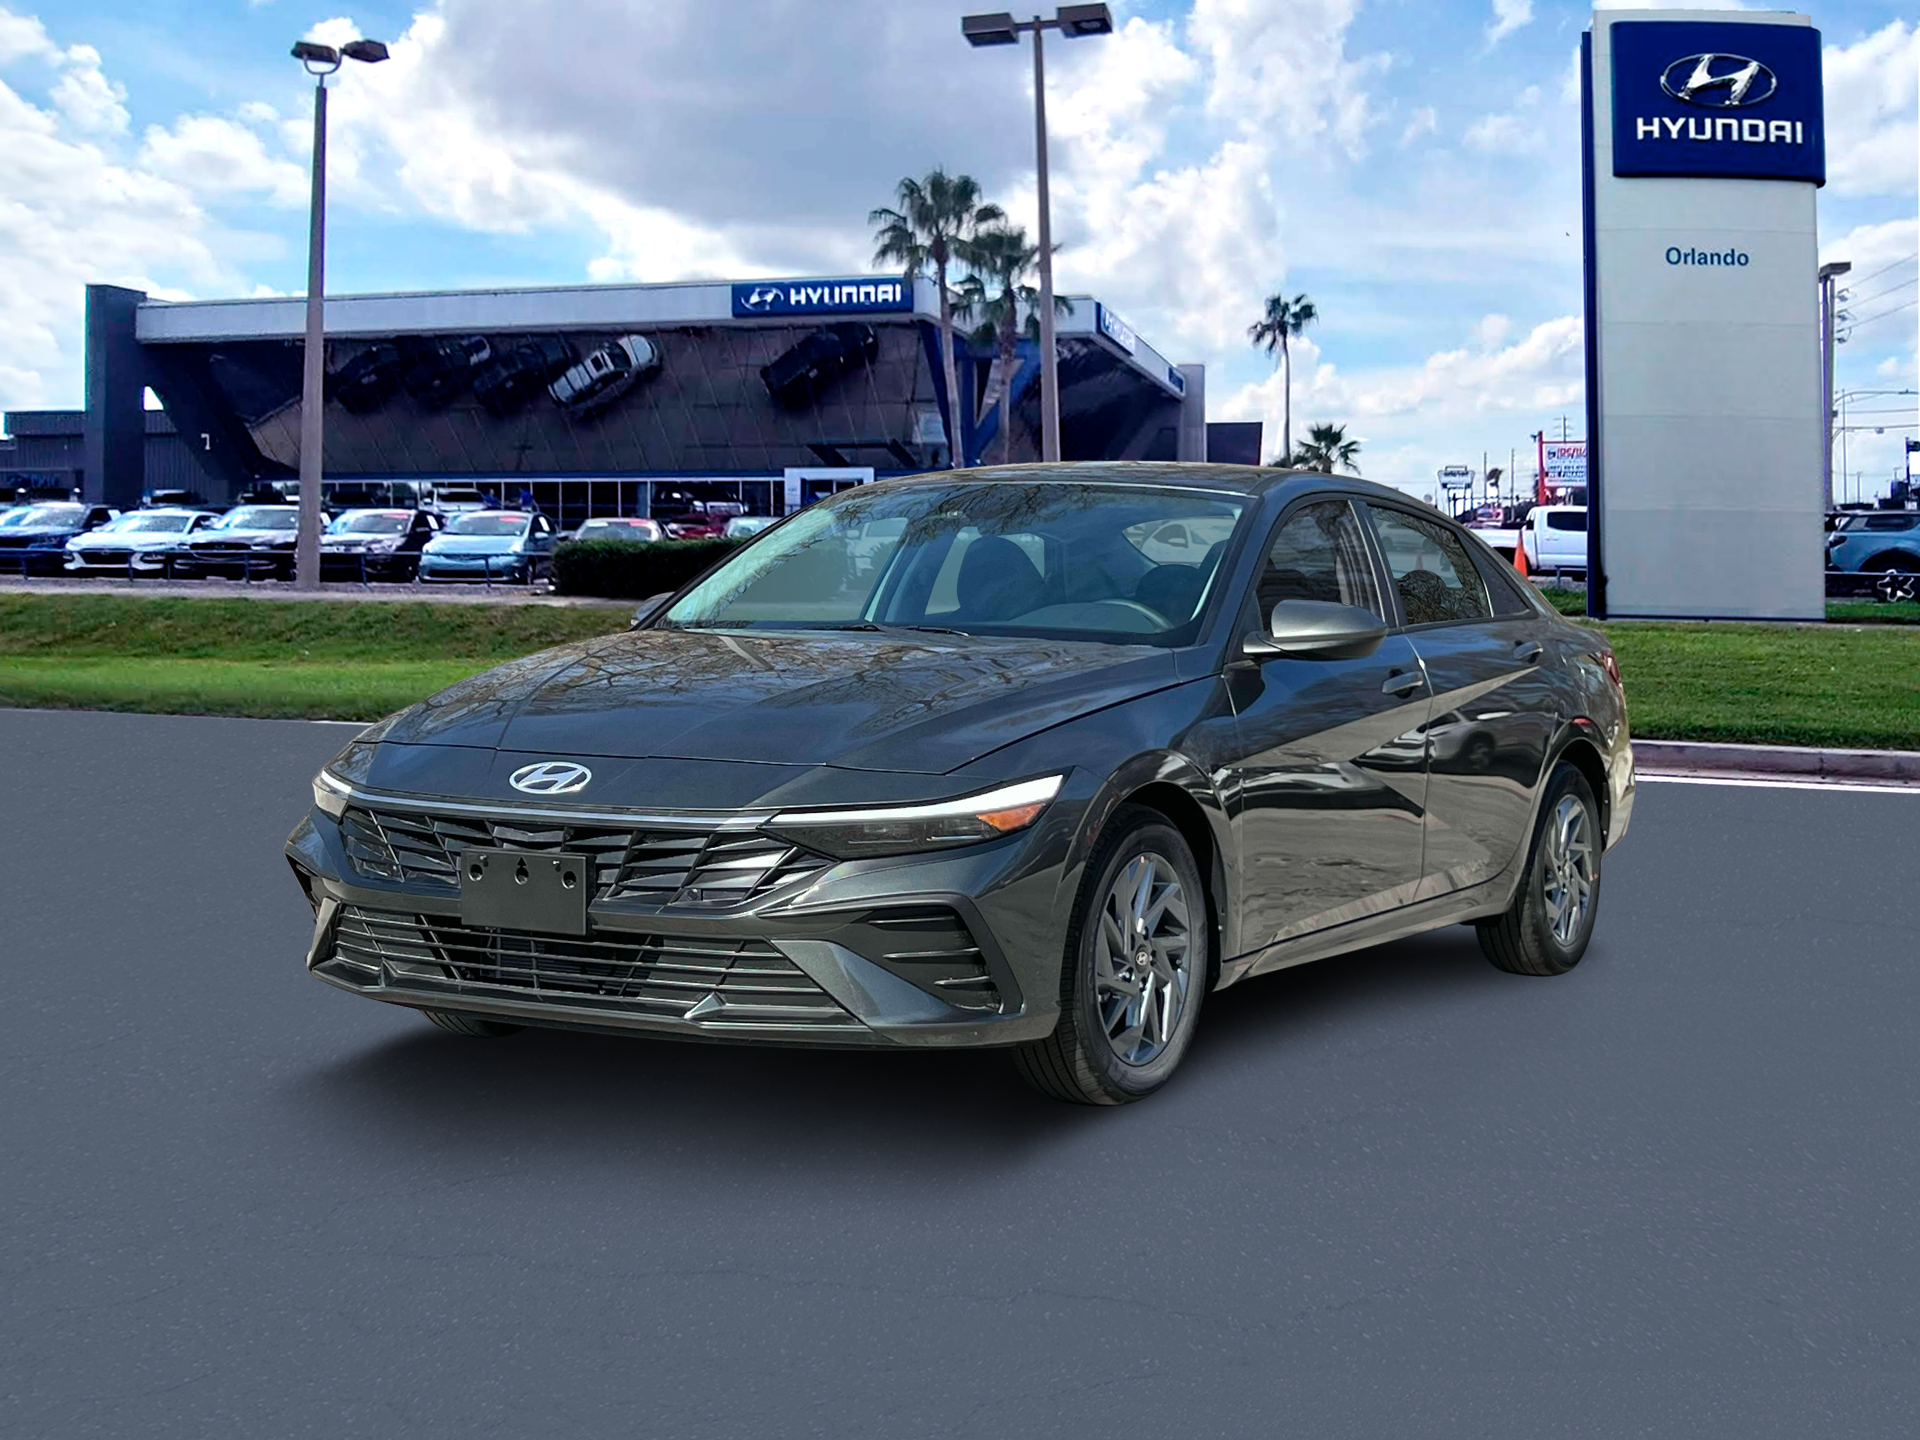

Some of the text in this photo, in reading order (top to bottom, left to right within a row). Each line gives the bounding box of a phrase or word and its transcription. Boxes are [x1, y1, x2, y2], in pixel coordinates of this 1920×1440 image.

[1636, 116, 1803, 145] HYUNDAI
[1665, 246, 1750, 267] Orlando
[789, 283, 901, 306] HYUNDAI
